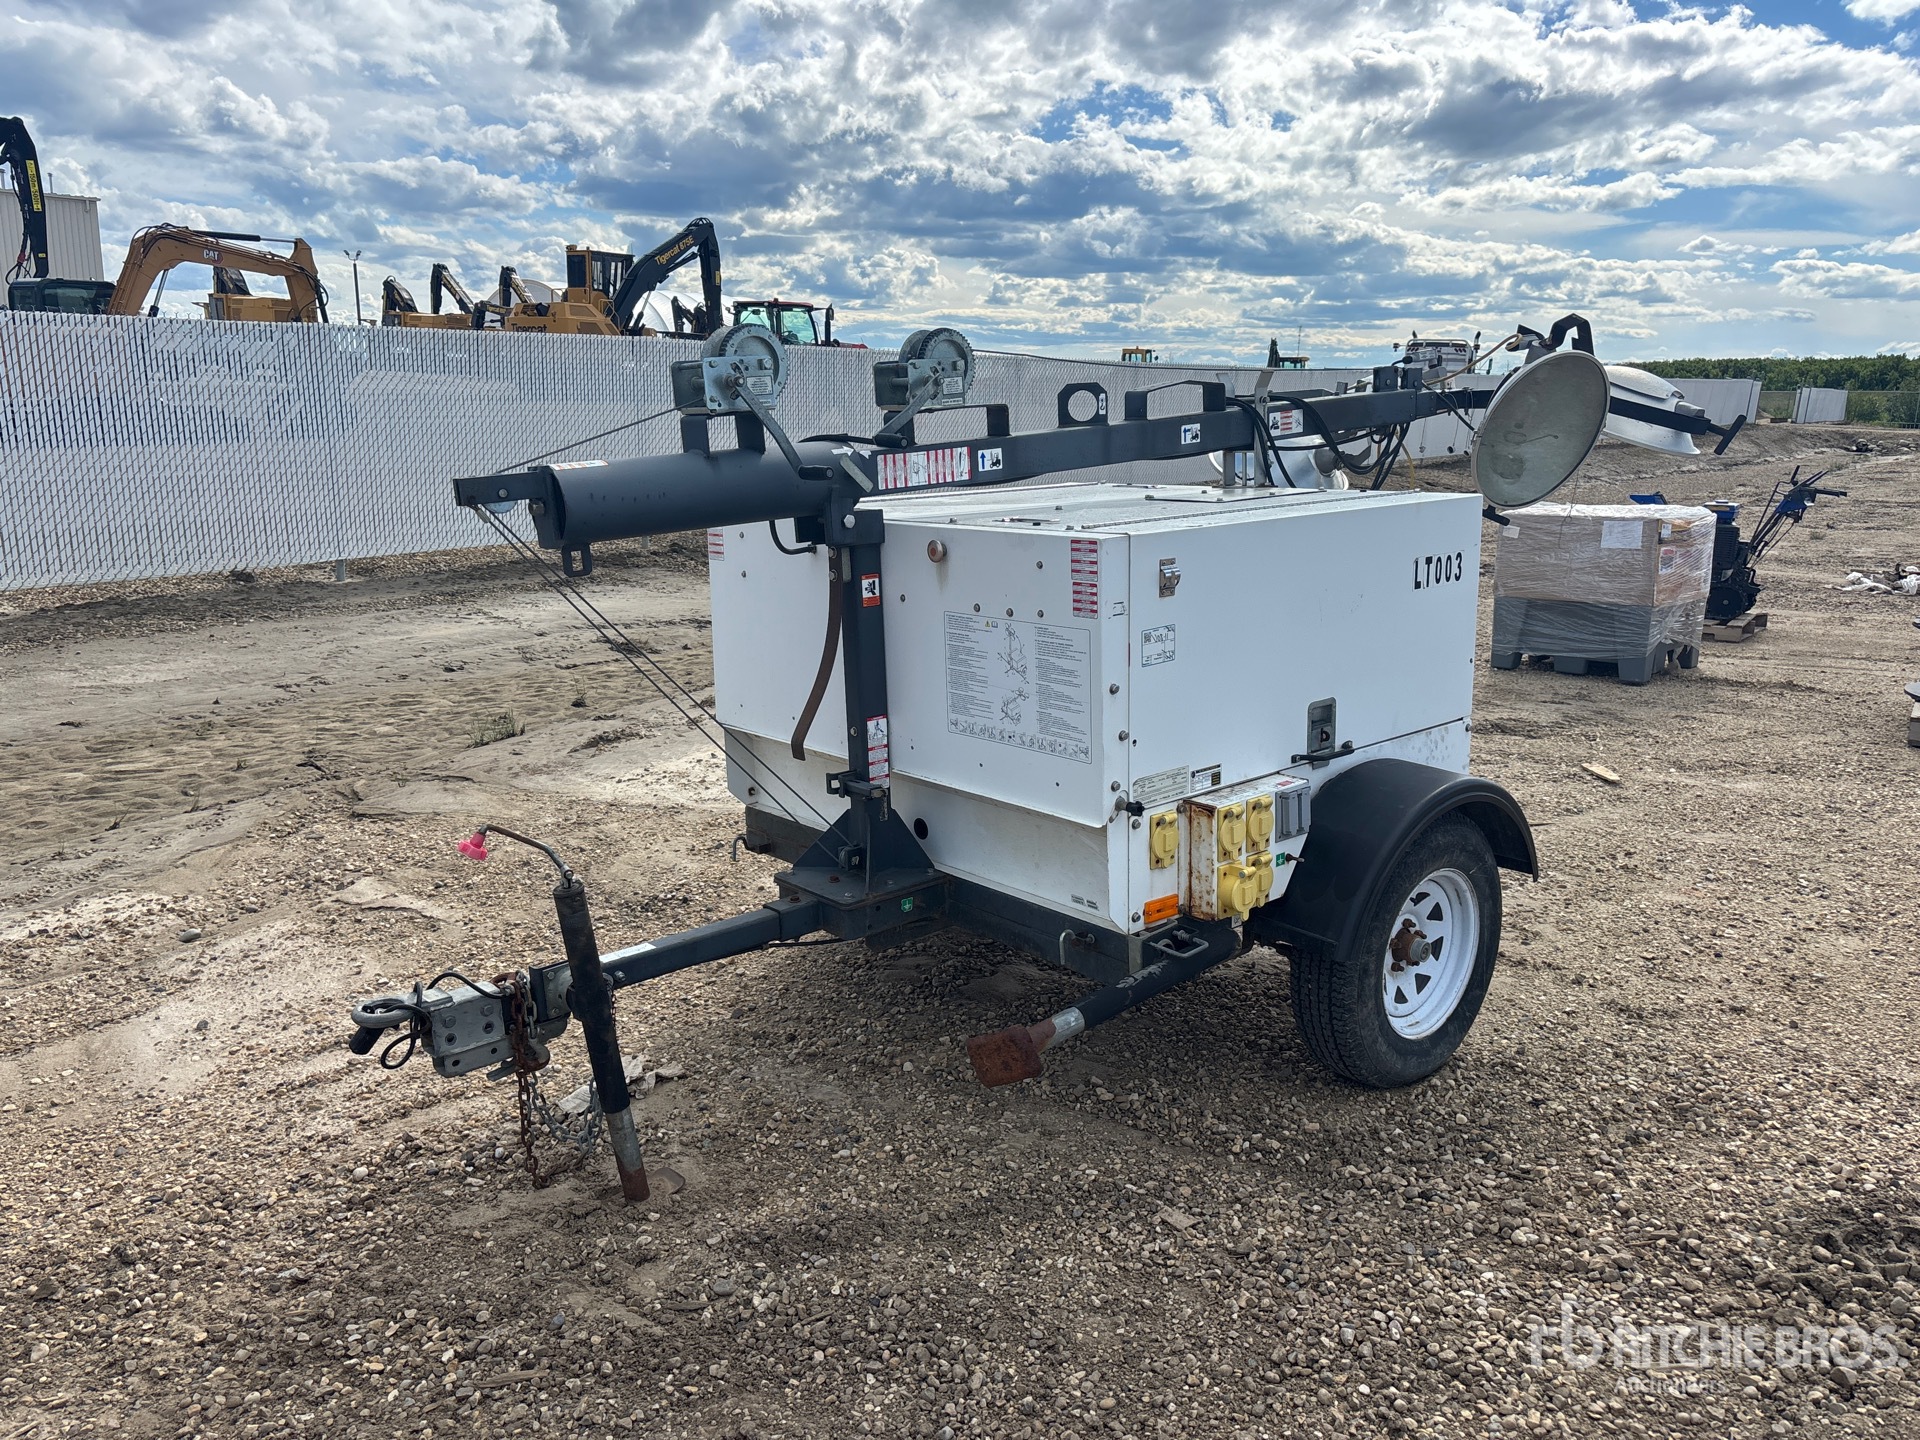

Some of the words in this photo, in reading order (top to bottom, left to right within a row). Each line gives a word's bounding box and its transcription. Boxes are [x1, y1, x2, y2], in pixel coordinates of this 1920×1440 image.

[203, 249, 219, 260] CAT
[654, 244, 680, 265] Tigercat
[1414, 551, 1463, 590] LT003
